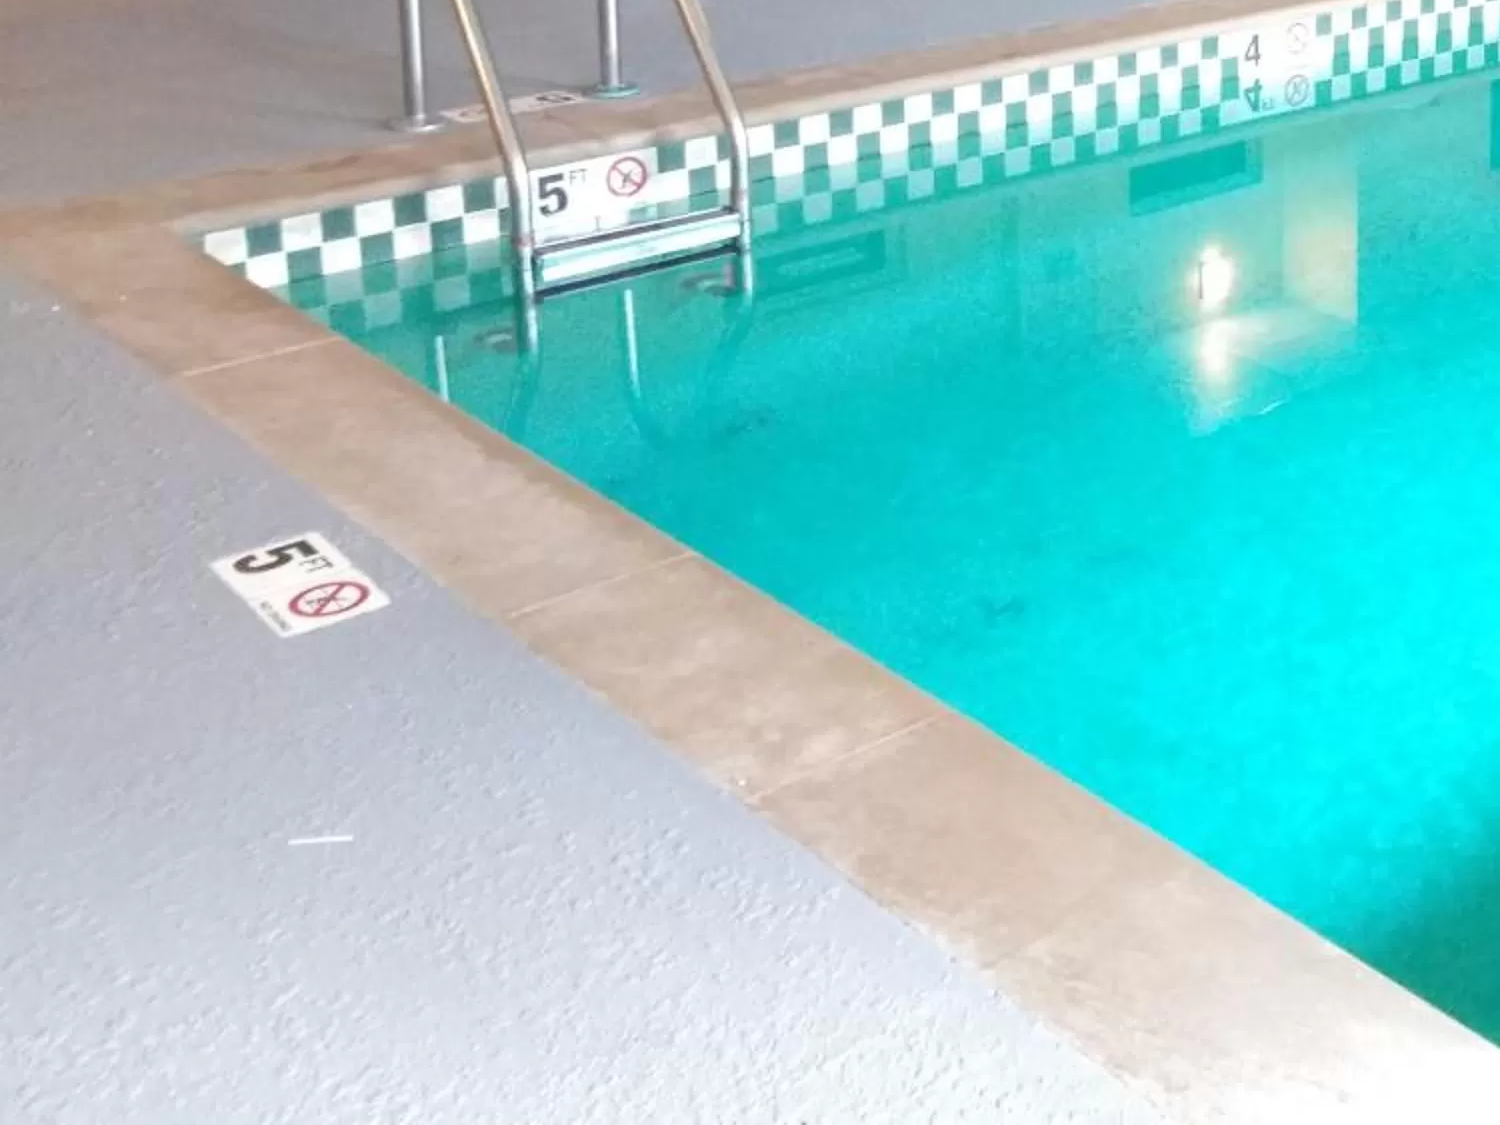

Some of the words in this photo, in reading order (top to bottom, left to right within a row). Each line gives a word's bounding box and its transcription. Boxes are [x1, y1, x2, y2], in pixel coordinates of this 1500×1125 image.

[1244, 34, 1261, 67] 4
[538, 172, 568, 217] 5
[232, 539, 319, 574] 5
